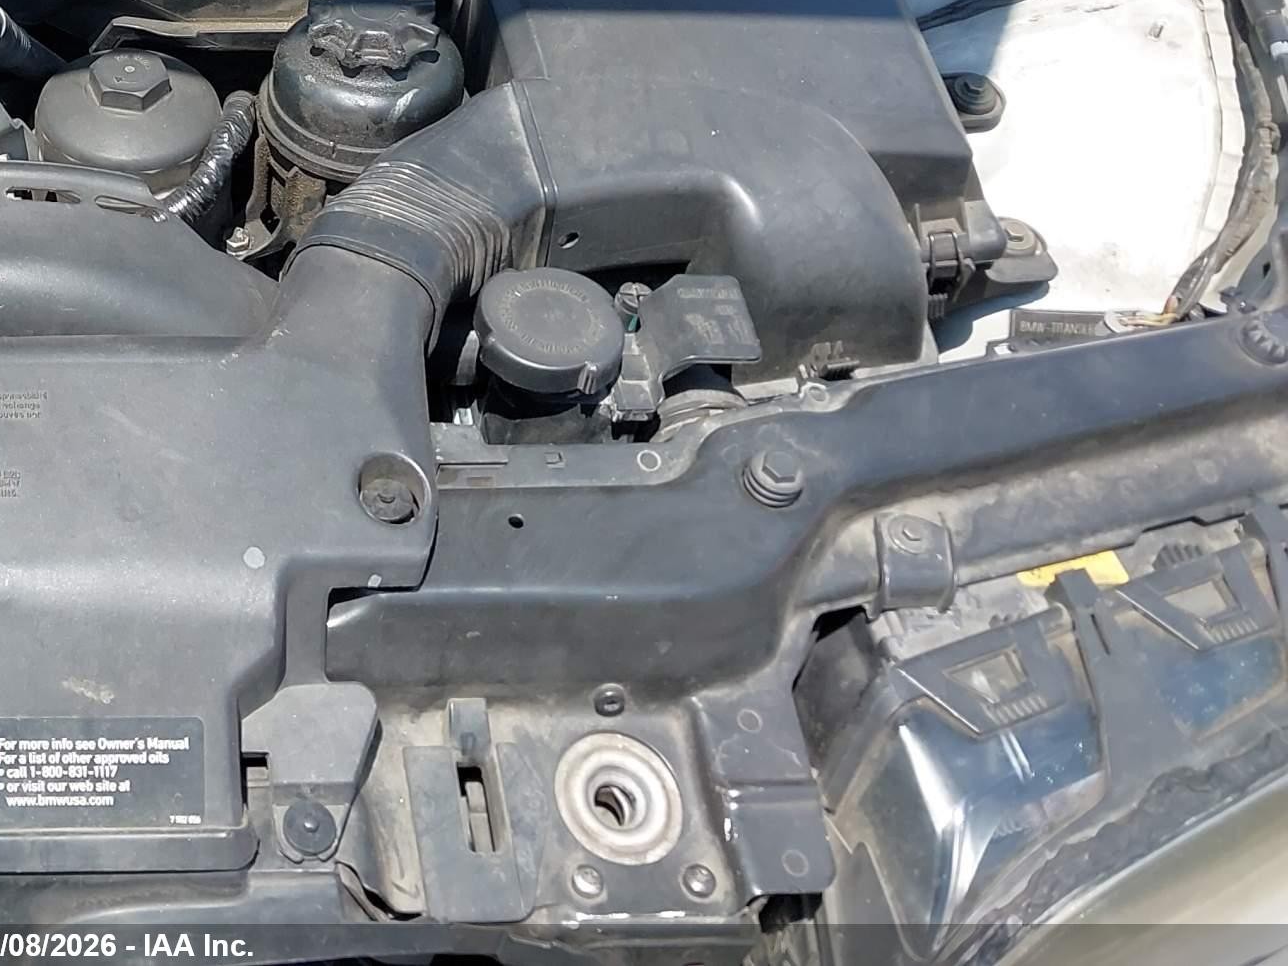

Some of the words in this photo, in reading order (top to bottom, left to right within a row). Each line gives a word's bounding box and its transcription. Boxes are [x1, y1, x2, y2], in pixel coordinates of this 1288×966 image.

[18, 740, 50, 750] more
[51, 737, 73, 750] info
[75, 740, 96, 750] see
[97, 737, 145, 750] Owner's
[146, 737, 189, 750] Manual
[18, 754, 26, 764] a
[28, 751, 47, 764] list
[48, 751, 61, 764] of
[62, 751, 92, 764] other
[93, 751, 147, 766] approved
[148, 751, 170, 764] oils
[6, 765, 27, 779] call
[29, 765, 118, 778] 1-800-831-1117
[6, 782, 20, 792] or
[21, 780, 46, 792] visit
[47, 782, 68, 792] our
[69, 779, 94, 792] web
[95, 779, 117, 792] site
[118, 779, 131, 792] at
[5, 794, 114, 807] www.bmwusa.com
